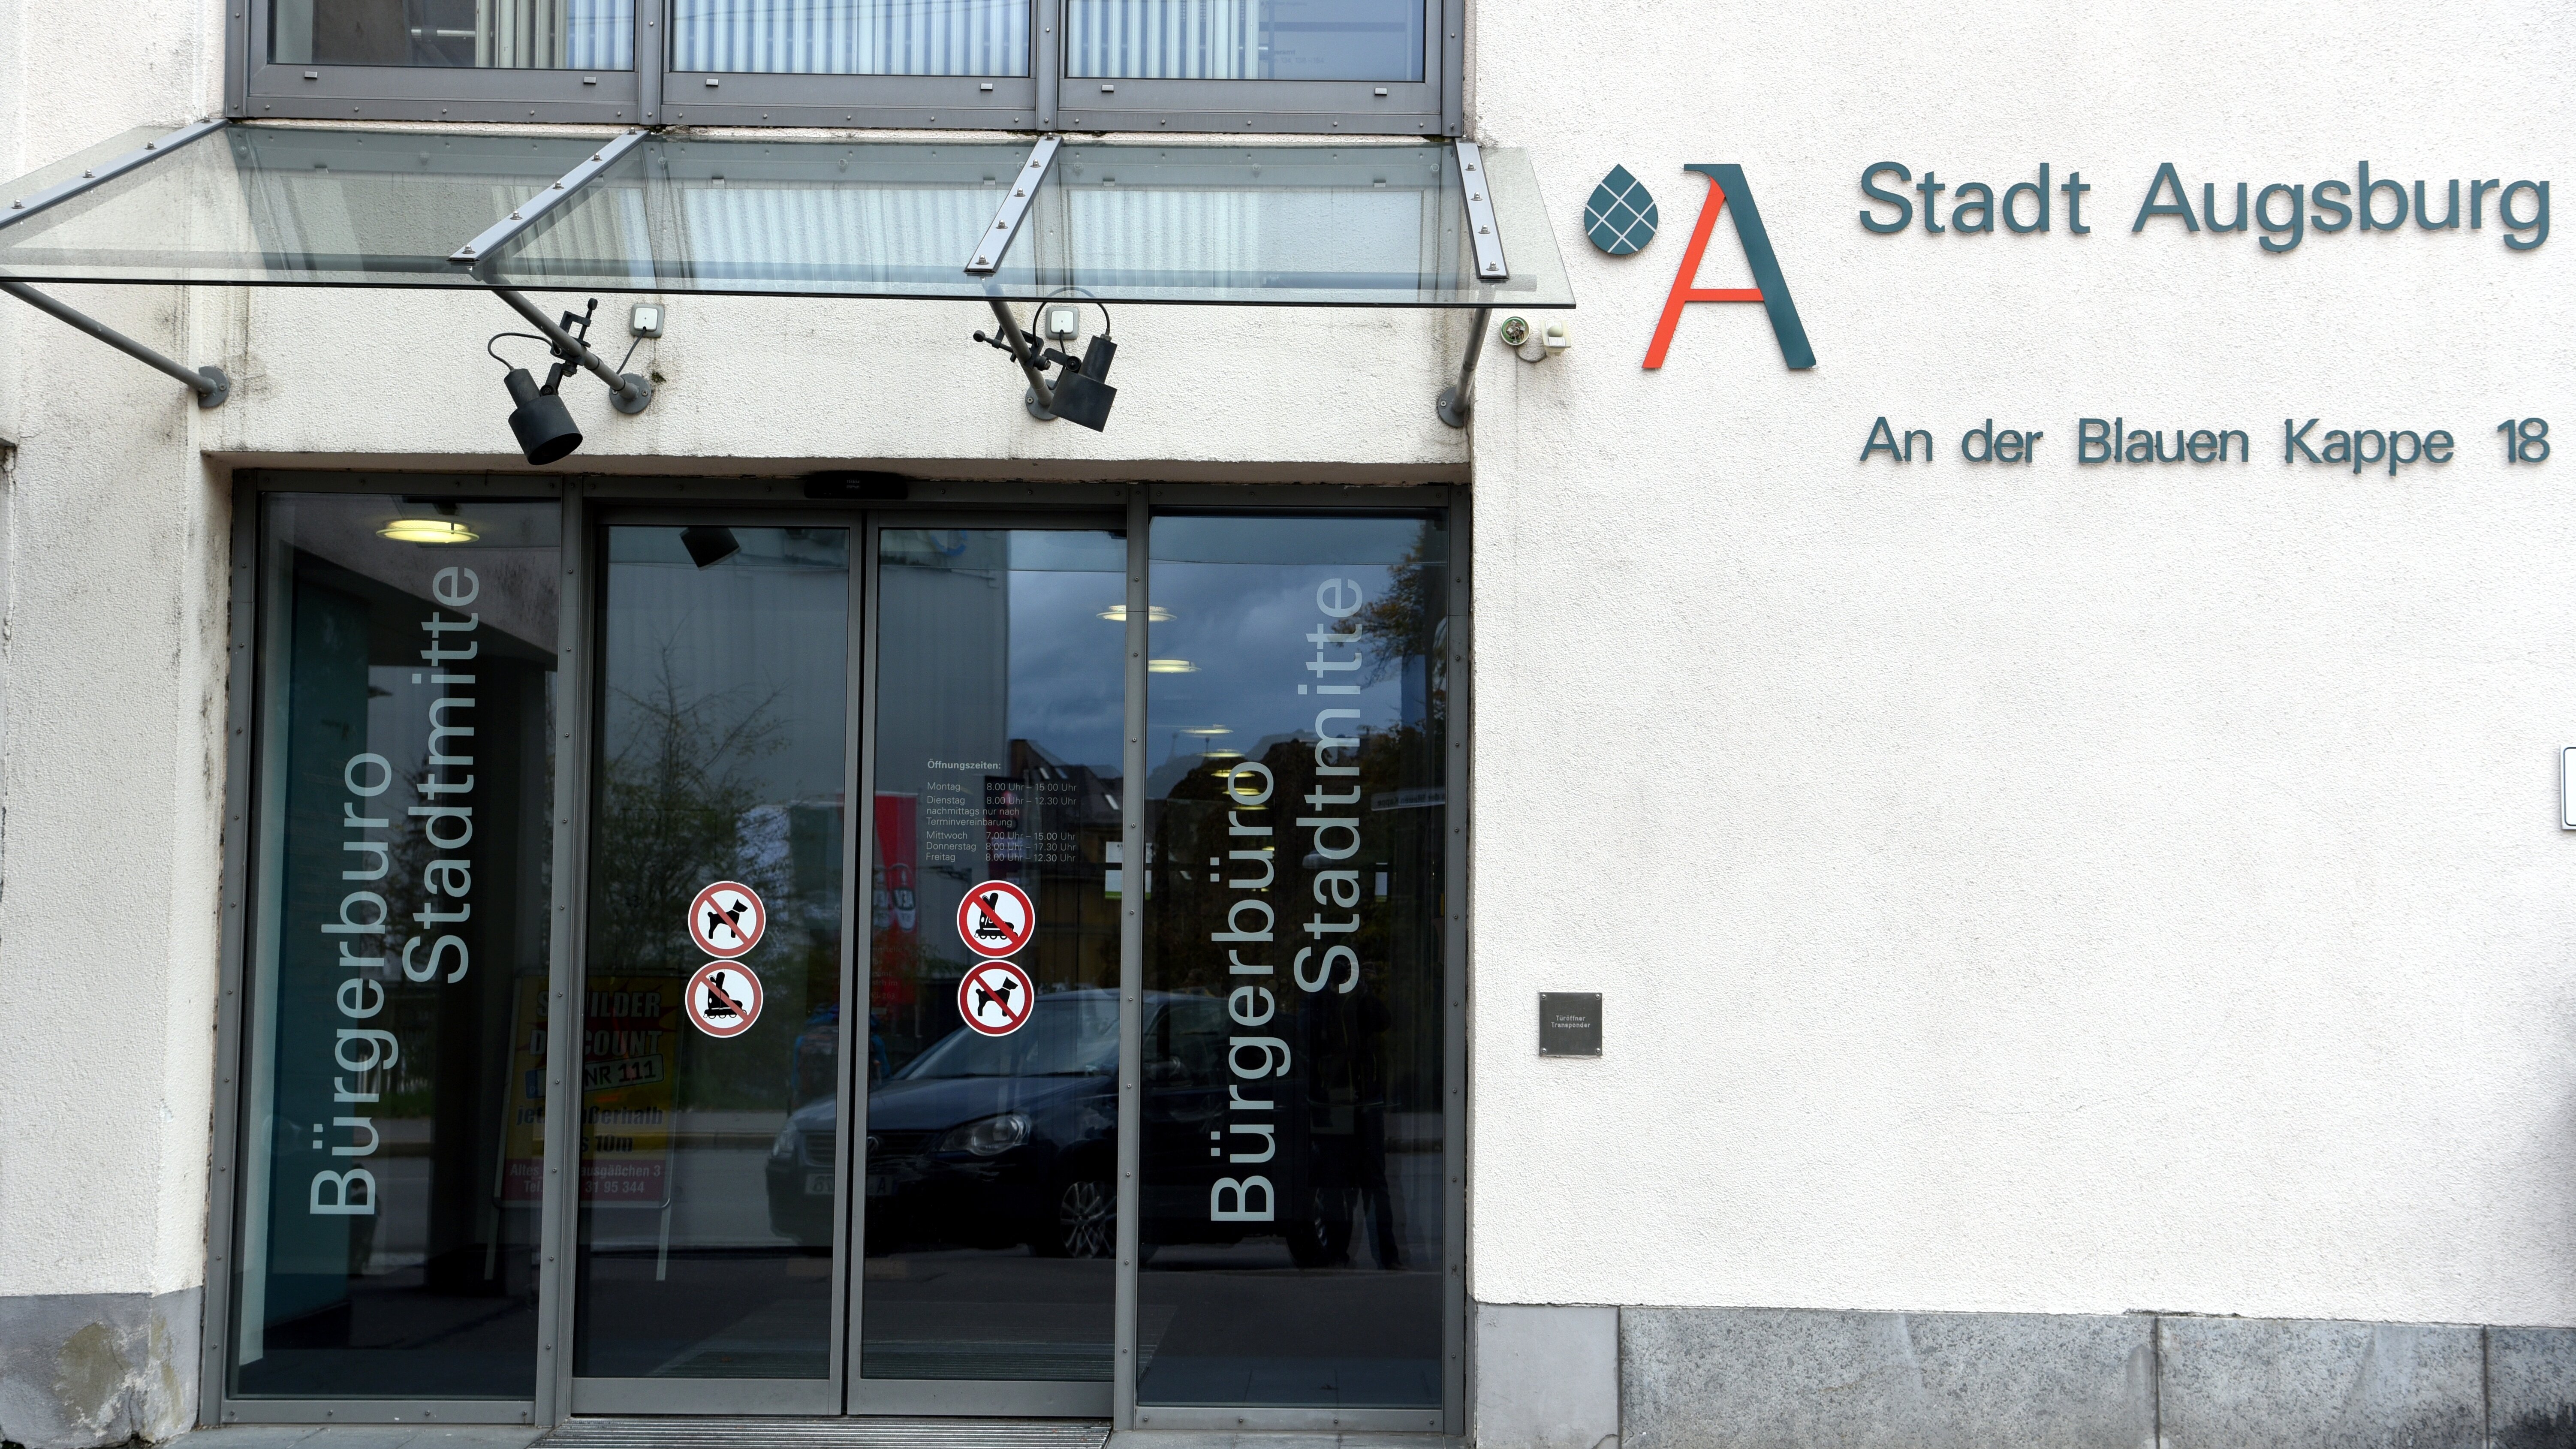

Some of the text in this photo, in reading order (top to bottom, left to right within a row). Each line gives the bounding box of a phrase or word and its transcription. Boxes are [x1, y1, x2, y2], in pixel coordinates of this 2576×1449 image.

[1859, 160, 2550, 253] Stadt Augsburg
[1859, 417, 2550, 476] An der Blauen Kappe 18
[928, 759, 1001, 770] Öffnungszeiten:
[403, 566, 479, 984] Stadtmitte
[927, 782, 961, 792] Montag
[1294, 578, 1363, 993] Stadtmitte
[927, 796, 965, 805] Dienstag
[927, 807, 979, 816] nachmittags
[926, 817, 1012, 828] Terminvereinbarung
[926, 831, 967, 839] Mittwoch
[926, 842, 976, 852] Donnerstag
[926, 853, 955, 862] Freitag
[986, 853, 1004, 862] 8.00
[1007, 853, 1023, 862] Uhr
[1033, 854, 1057, 862] 12.30
[1060, 854, 1076, 862] Uhr
[1211, 761, 1290, 1222] Bürgerbüro
[536, 991, 662, 1018] SILDER
[530, 1029, 663, 1057] DOUNT
[618, 1060, 656, 1082] 111
[583, 1105, 663, 1125] ßerhalb
[596, 1134, 633, 1153] 10m
[510, 1164, 539, 1176] Altes
[654, 1165, 661, 1177] 3
[603, 1181, 618, 1193] 95
[623, 1181, 645, 1193] 344
